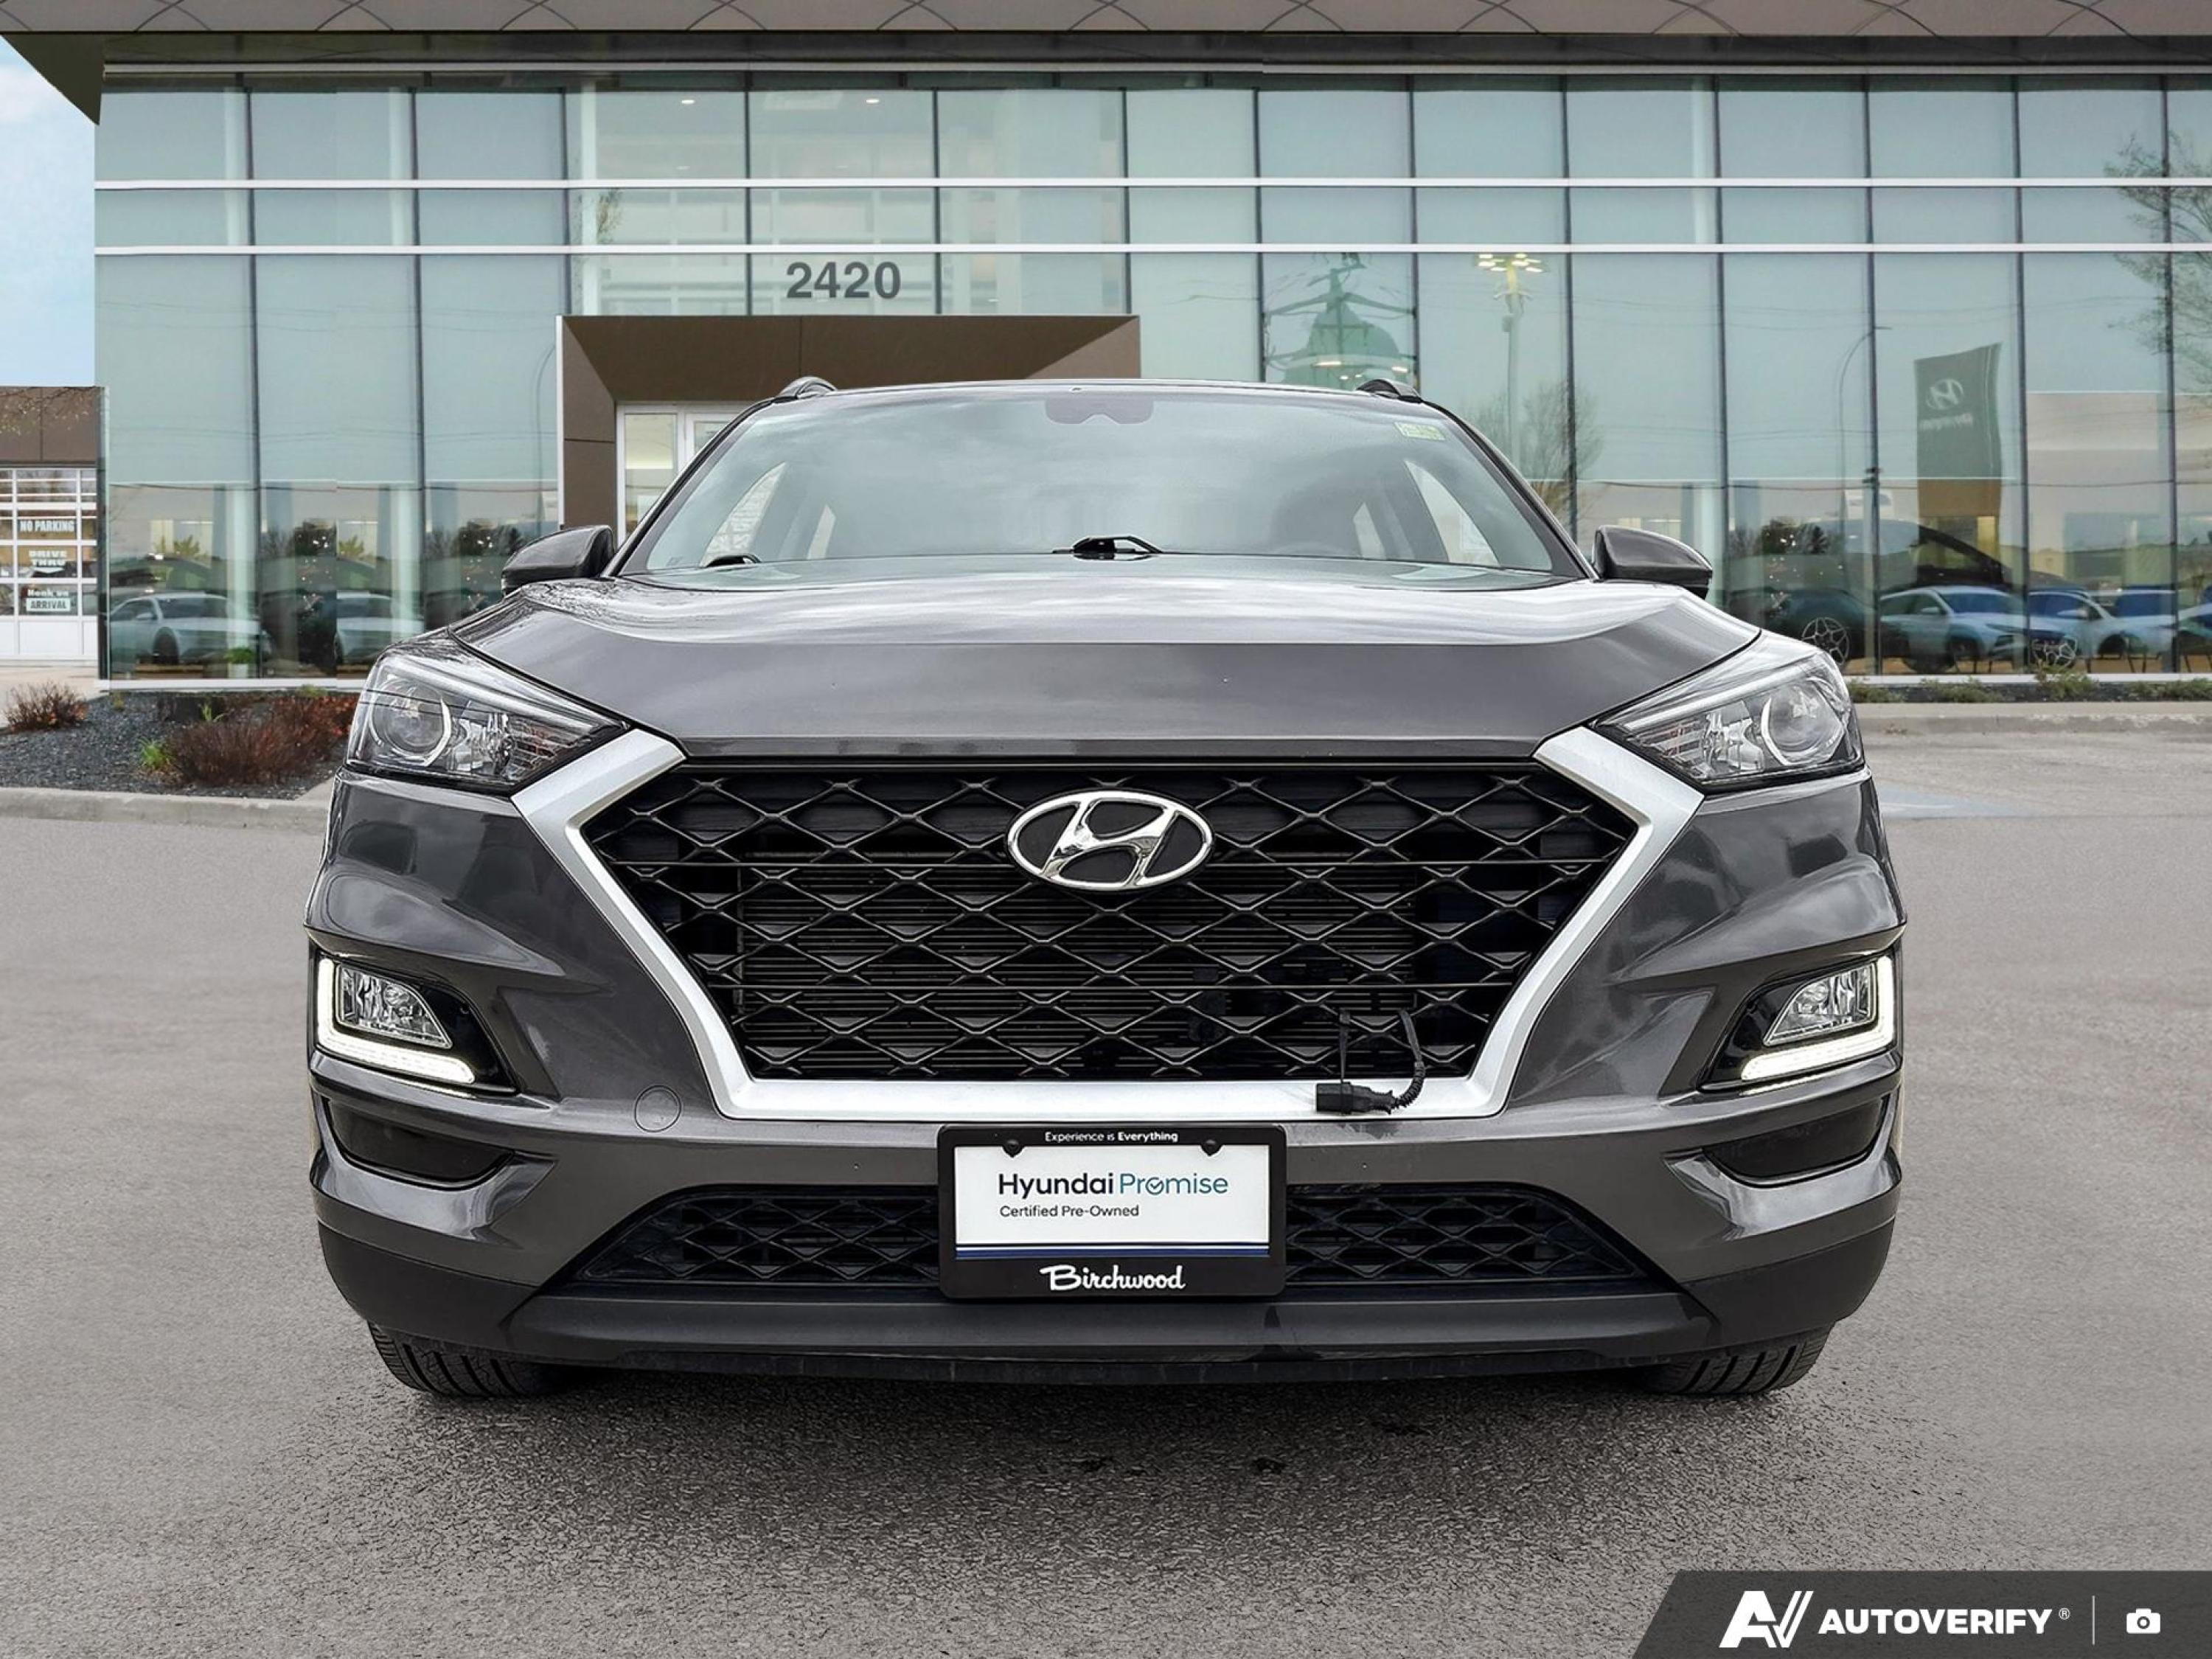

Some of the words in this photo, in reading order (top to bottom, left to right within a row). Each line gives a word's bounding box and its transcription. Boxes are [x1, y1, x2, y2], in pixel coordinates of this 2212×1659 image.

[786, 262, 901, 299] 2420
[20, 520, 33, 532] NO
[34, 520, 74, 532] PARKING
[30, 600, 67, 609] ARRIVAL
[1045, 1132, 1105, 1143] Experience
[1107, 1132, 1116, 1141] is
[1118, 1132, 1178, 1143] Everything
[998, 1172, 1114, 1199] Hyundai
[1120, 1172, 1229, 1195] Promise
[999, 1205, 1058, 1217] Certified
[1061, 1205, 1139, 1217] Pre-Owned
[1039, 1265, 1186, 1290] Birchwood
